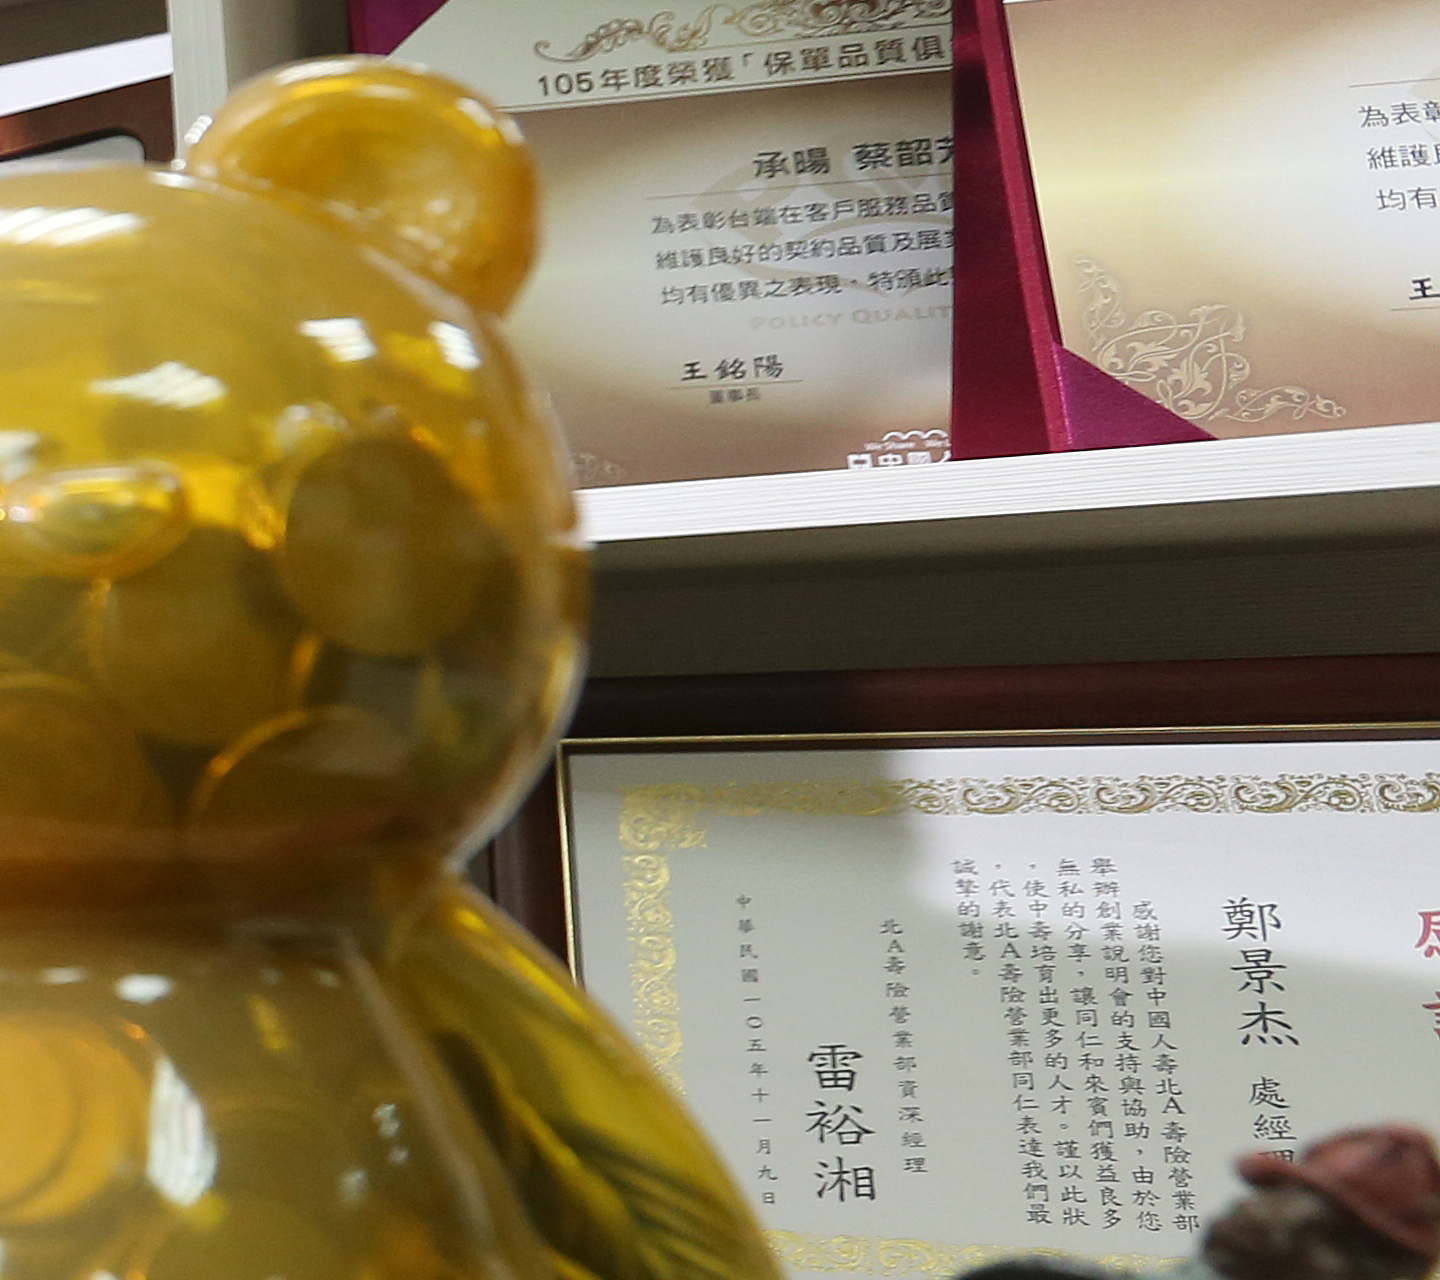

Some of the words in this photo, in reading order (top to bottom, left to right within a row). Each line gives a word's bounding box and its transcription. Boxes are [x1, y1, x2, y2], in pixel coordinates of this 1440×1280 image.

[1367, 143, 1440, 172] 維護
[1376, 185, 1437, 211] 均有
[681, 354, 784, 382] 王銘陽
[880, 918, 928, 1174] 北A壽險營業部資深經理
[1221, 897, 1300, 1046] 鄭景杰
[805, 1043, 877, 1203] 雷裕湘
[1132, 900, 1200, 1233] 感謝您對中國人壽北A壽險營業部
